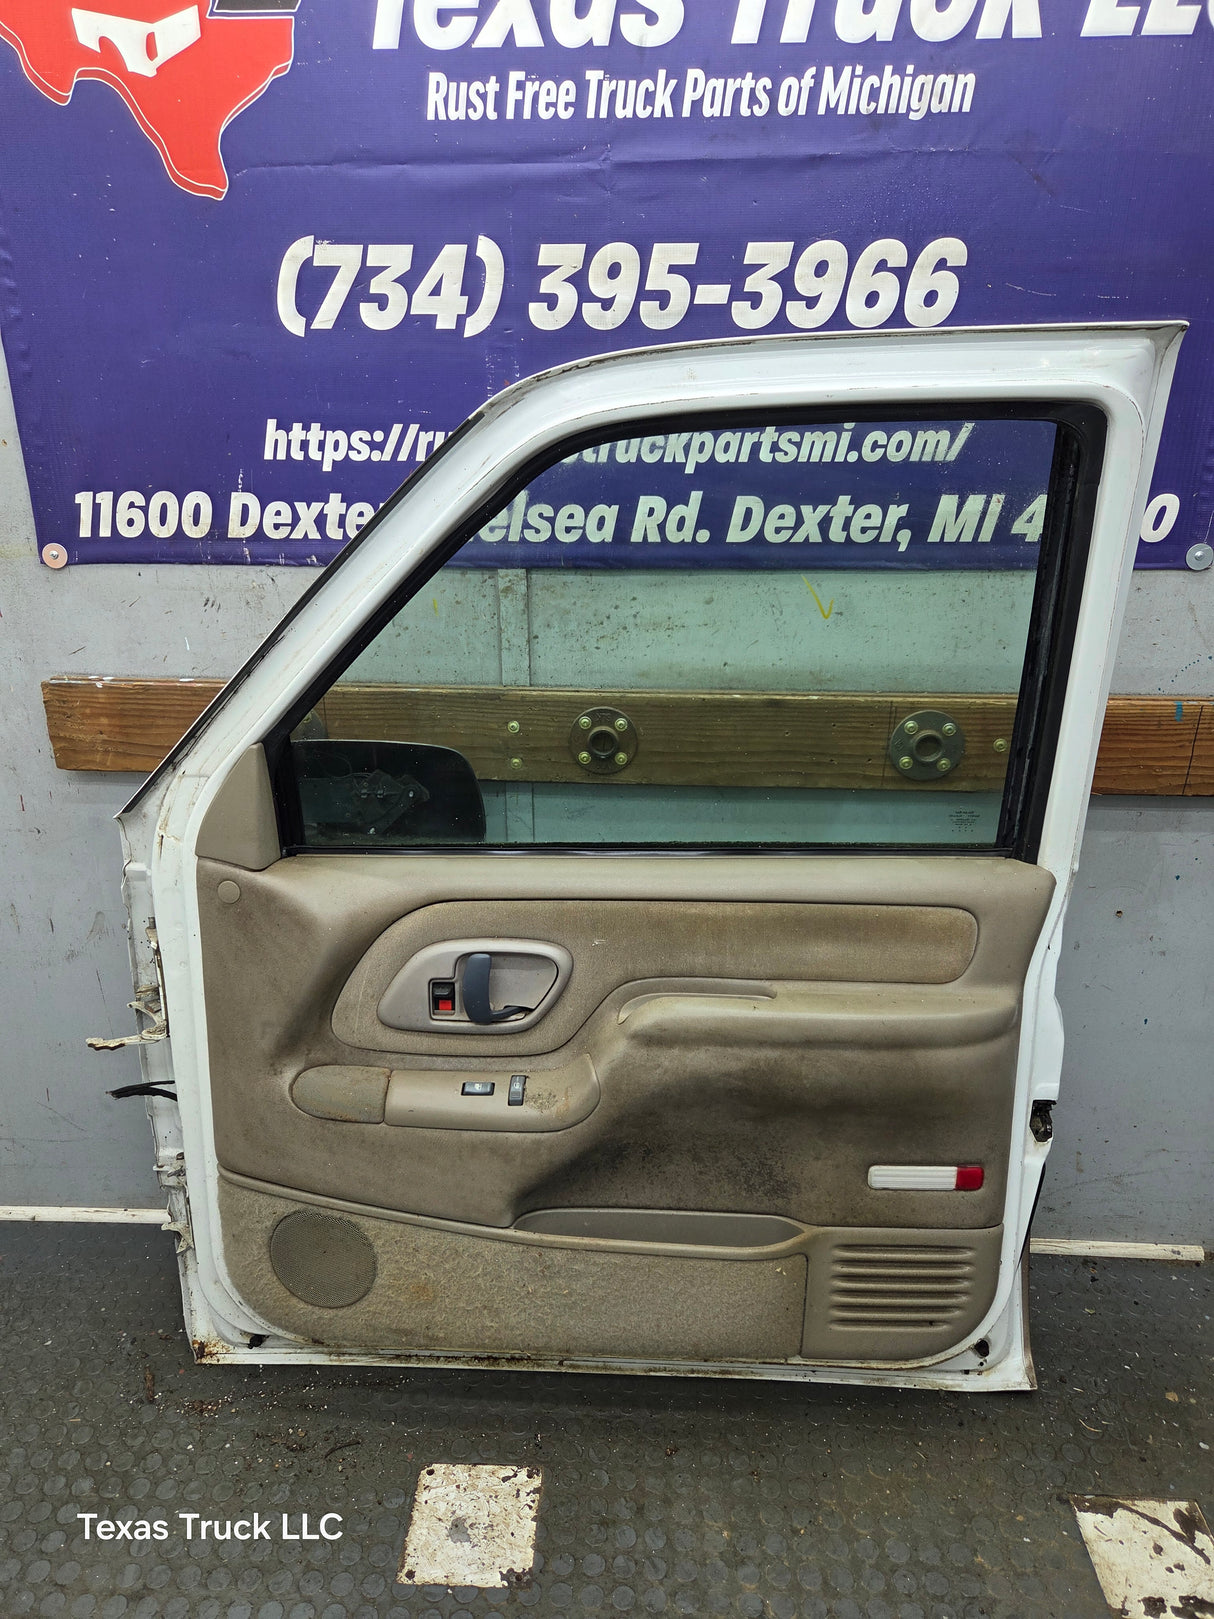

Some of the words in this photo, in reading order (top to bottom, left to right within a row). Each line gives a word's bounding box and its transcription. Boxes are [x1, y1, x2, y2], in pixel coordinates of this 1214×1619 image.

[427, 71, 500, 121] Rust
[506, 70, 577, 120] Free
[585, 68, 678, 119] Truck
[681, 68, 772, 118] Parts
[777, 66, 816, 116] of
[817, 64, 976, 121] Michigan
[277, 234, 505, 338] (734)
[528, 237, 968, 331] 395-3966
[74, 490, 214, 539] 11600
[227, 491, 384, 541] Dexte
[630, 490, 711, 544] Rd.
[725, 495, 912, 552] Dexter,
[926, 493, 1006, 543] MI
